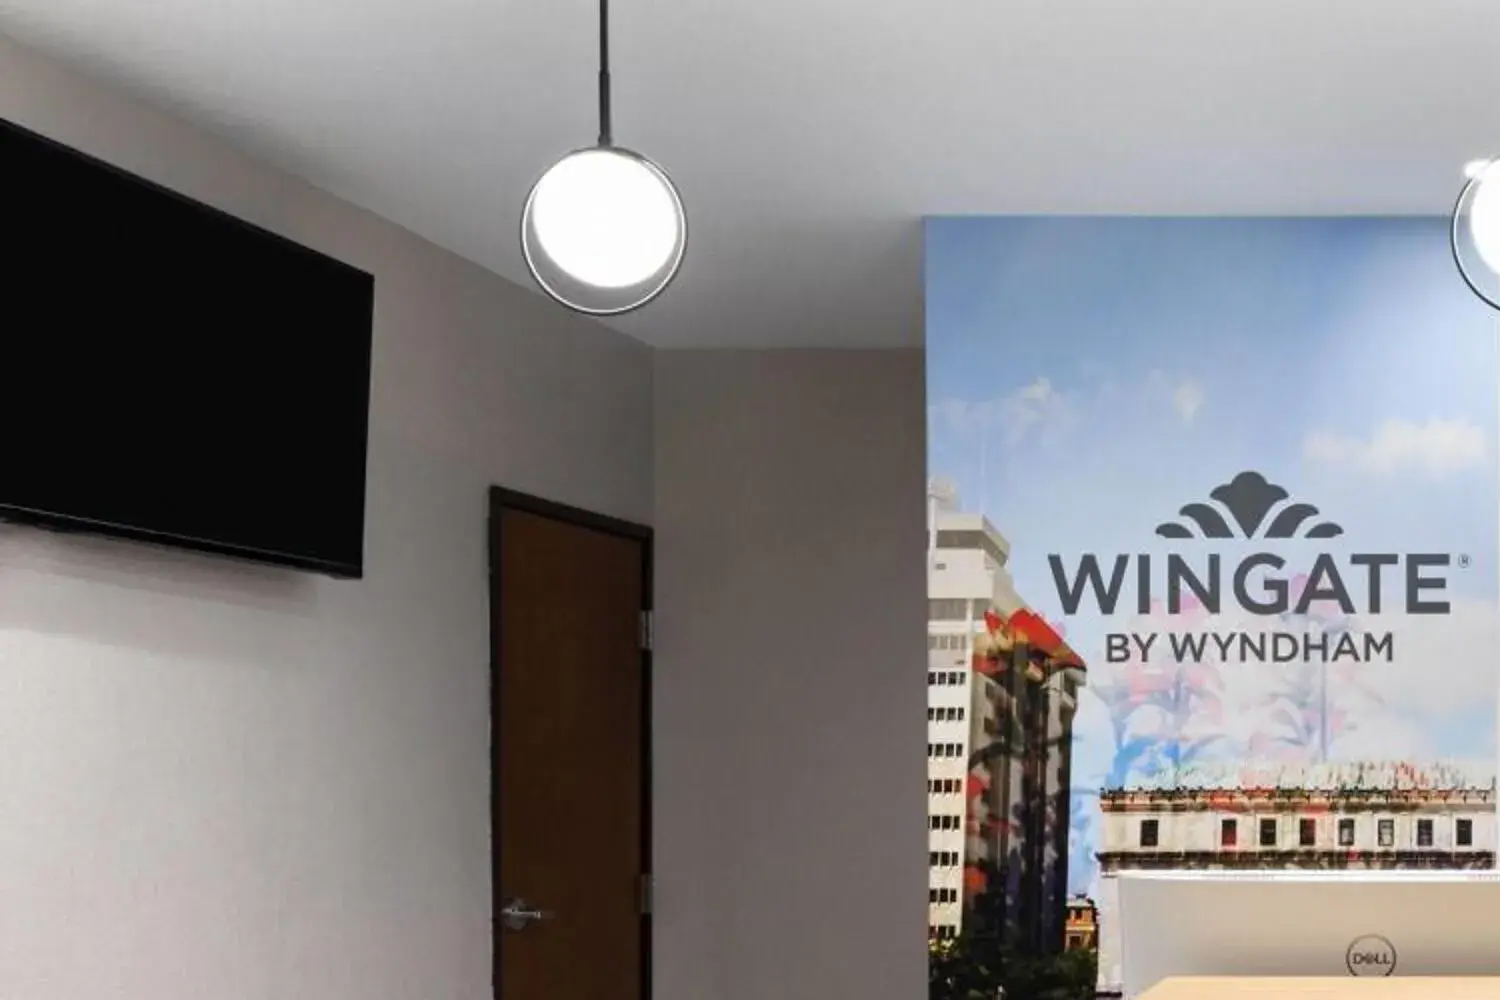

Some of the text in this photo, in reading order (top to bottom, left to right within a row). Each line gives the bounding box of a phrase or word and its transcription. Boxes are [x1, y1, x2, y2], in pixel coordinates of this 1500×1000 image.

[1047, 552, 1451, 615] WINGATE
[1105, 632, 1394, 663] BY WYNDHAM
[1352, 952, 1392, 965] DELL
